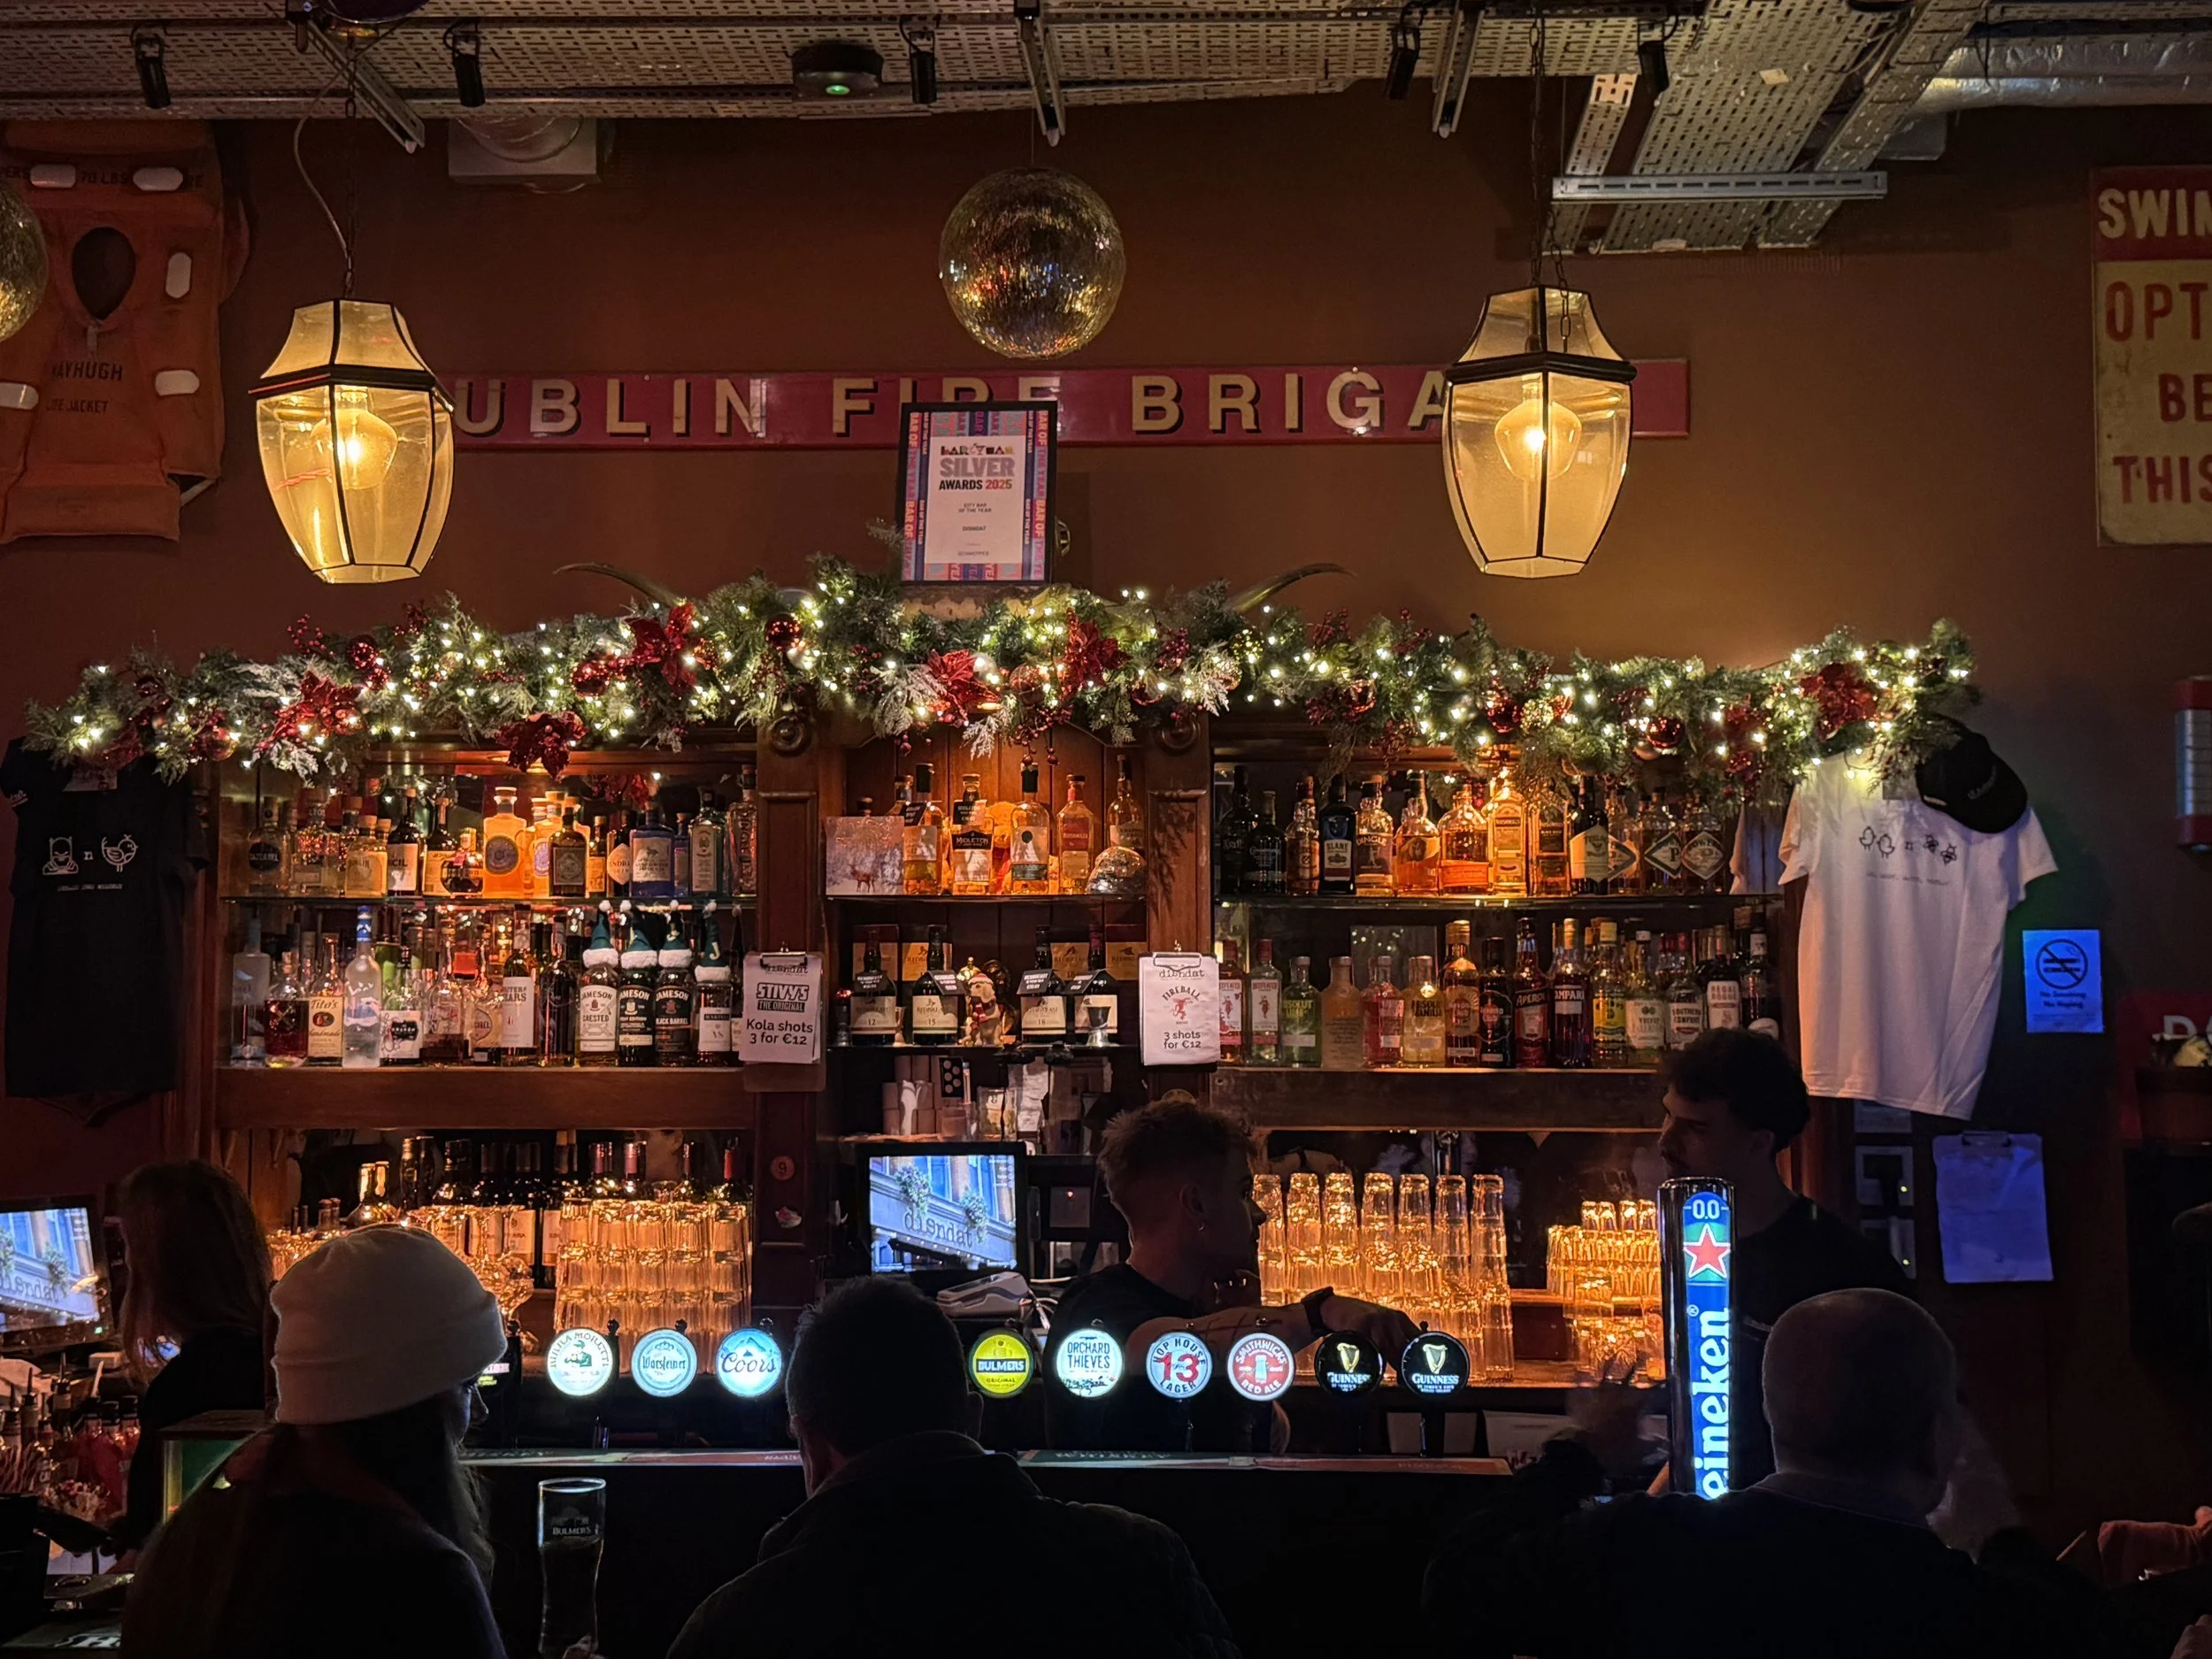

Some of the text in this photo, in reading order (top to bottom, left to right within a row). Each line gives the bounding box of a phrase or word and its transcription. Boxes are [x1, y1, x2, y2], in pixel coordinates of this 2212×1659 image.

[455, 379, 766, 435] UBLIN
[1131, 370, 1448, 432] BRIGA
[940, 457, 1015, 477] SILVER
[939, 479, 1012, 490] AWARDS 2025
[581, 991, 613, 1000] JAMESON
[619, 989, 650, 1001] AMESON
[1162, 985, 1202, 1001] FIREBALL
[1517, 993, 1546, 1006] APEROL
[1555, 990, 1585, 1001] AMPARI
[747, 1018, 813, 1033] Kola shots
[749, 1032, 807, 1045] 3 for €12
[1172, 1030, 1201, 1039] shots
[1164, 1039, 1202, 1049] for €12
[1692, 1199, 1721, 1220] 0.0
[1067, 1342, 1110, 1355] ORCHARD
[1153, 1338, 1206, 1365] HOP HOUSE
[720, 1352, 776, 1373] Coors
[978, 1361, 1024, 1371] BULMERS
[1067, 1355, 1110, 1369] THIEVES
[1159, 1351, 1201, 1383] 13
[1411, 1373, 1459, 1385] GUINNESS
[1160, 1379, 1196, 1394] LAGER
[1240, 1379, 1282, 1394] RED ALE
[1692, 1308, 1731, 1501] eineken
